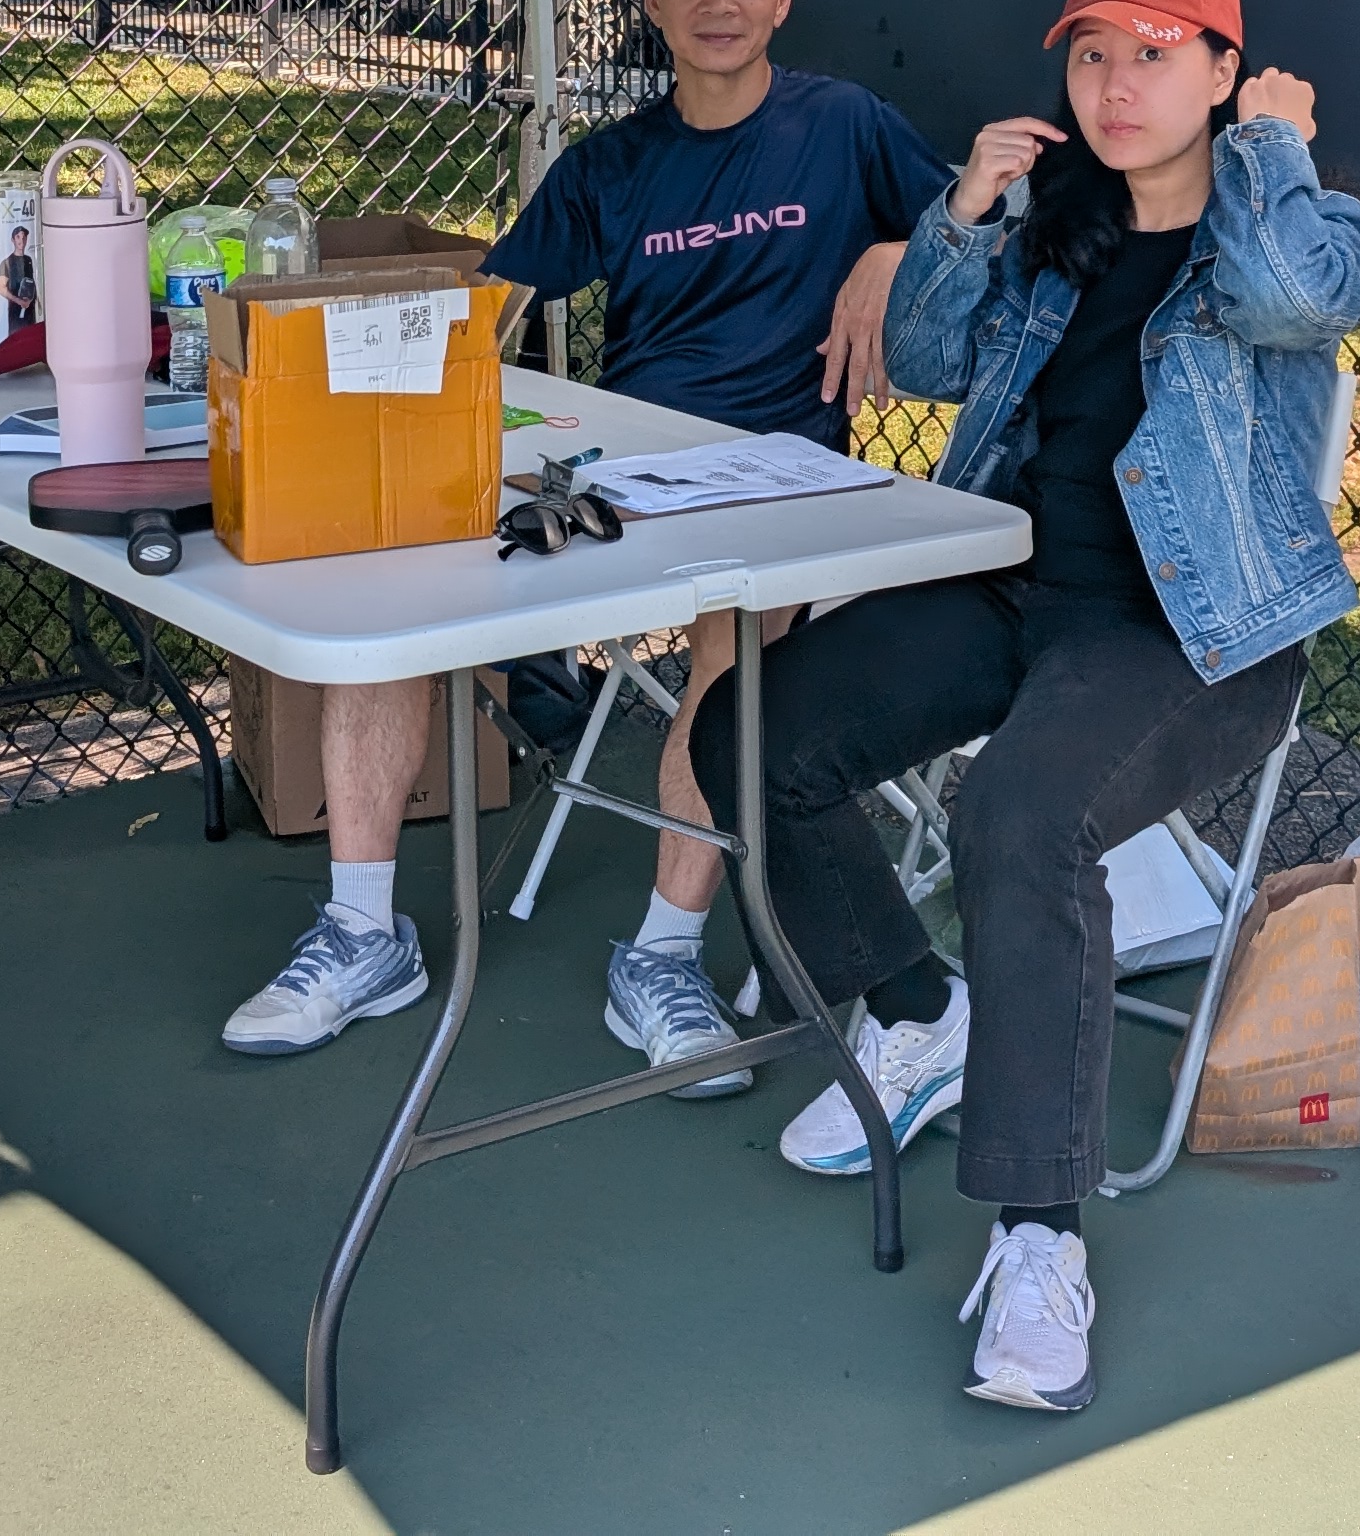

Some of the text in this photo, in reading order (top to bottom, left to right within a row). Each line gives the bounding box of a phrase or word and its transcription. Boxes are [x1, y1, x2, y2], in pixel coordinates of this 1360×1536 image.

[1, 198, 35, 220] X-40
[645, 204, 806, 256] MIZUNO
[193, 277, 216, 287] Pure
